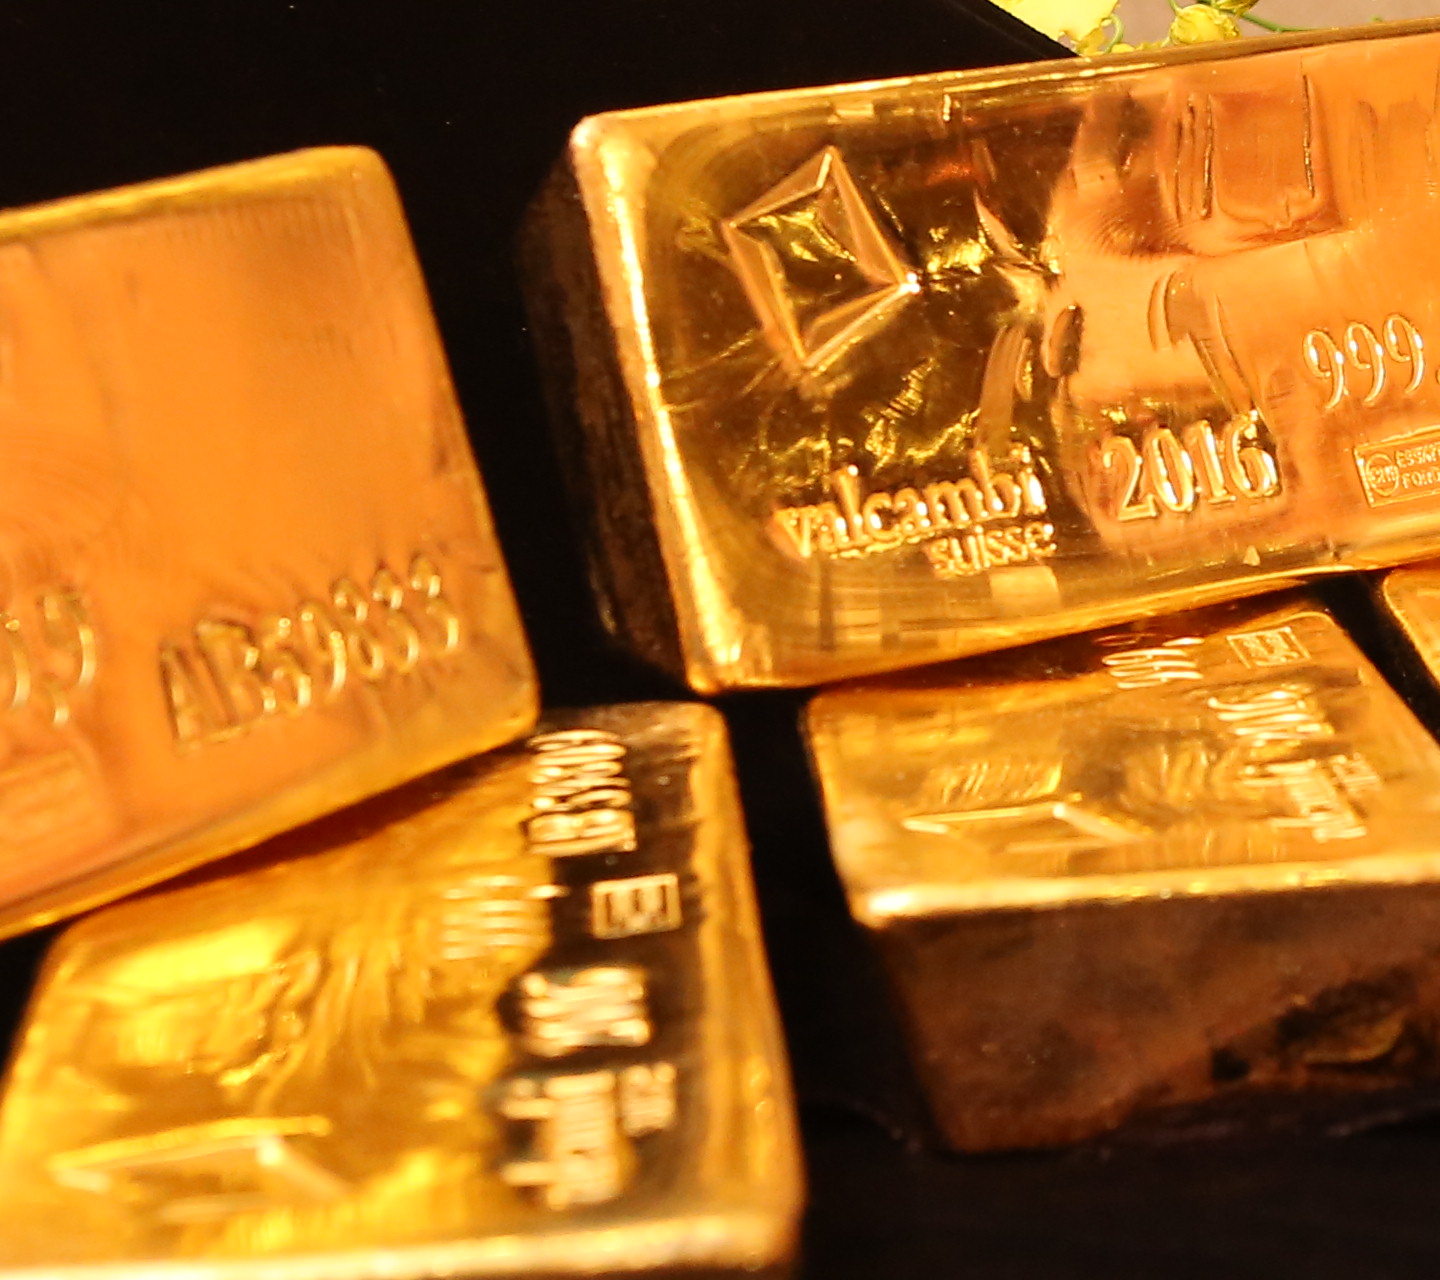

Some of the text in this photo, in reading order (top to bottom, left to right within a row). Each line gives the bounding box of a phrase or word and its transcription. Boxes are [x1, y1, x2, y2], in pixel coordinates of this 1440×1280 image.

[769, 411, 1284, 558] valcambi 2016
[923, 519, 1058, 578] suisse
